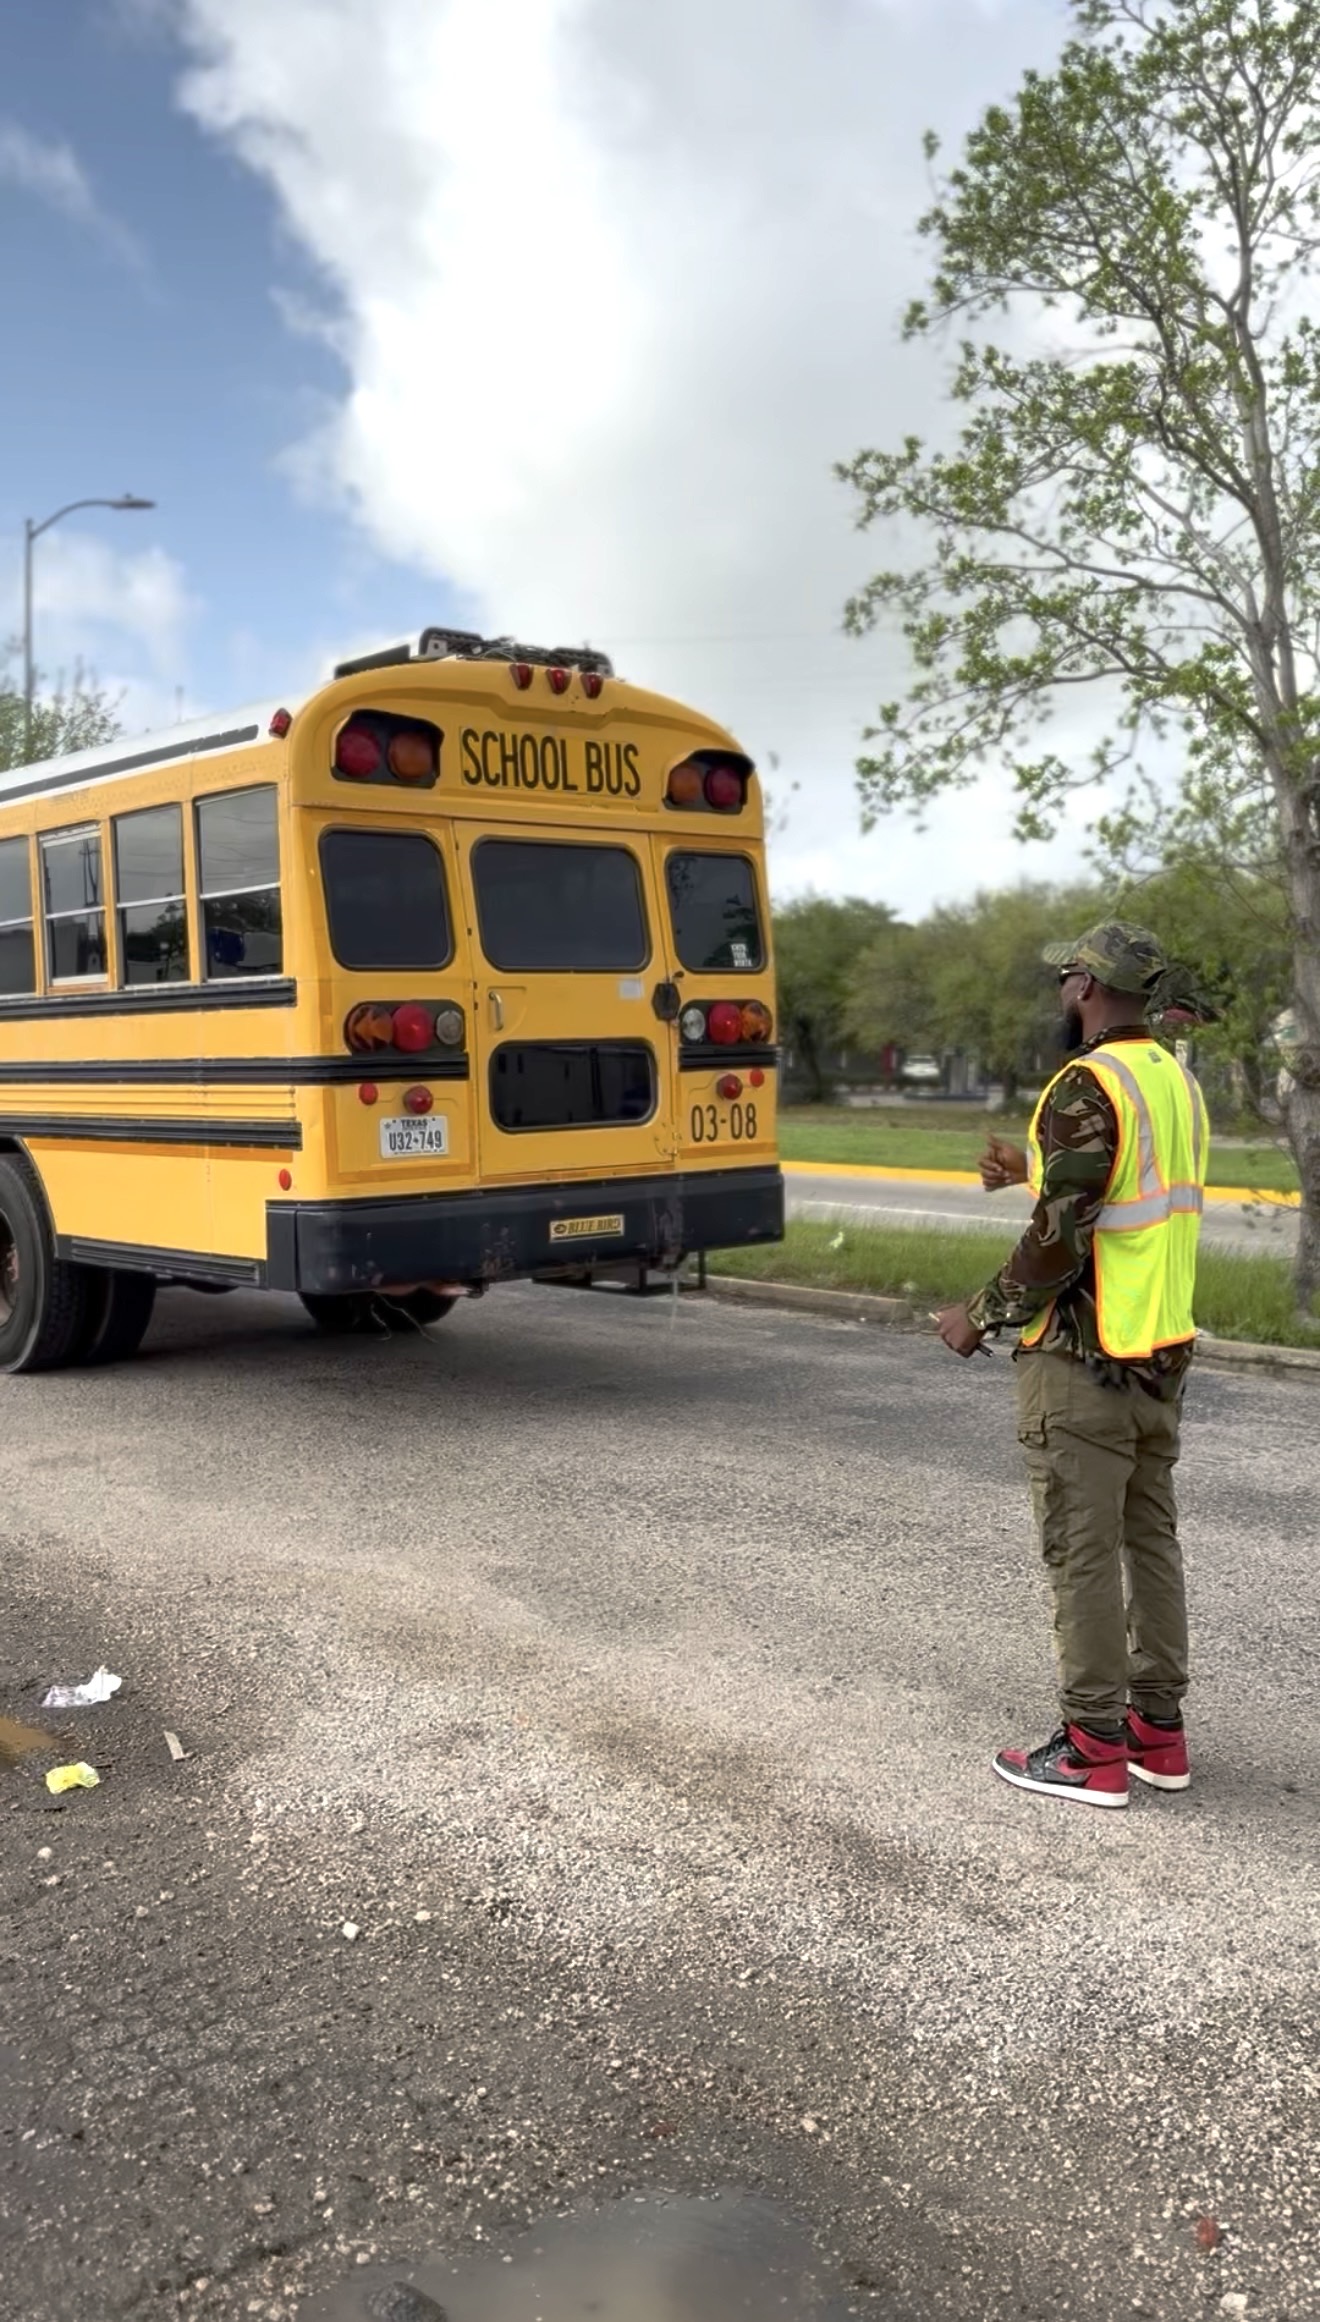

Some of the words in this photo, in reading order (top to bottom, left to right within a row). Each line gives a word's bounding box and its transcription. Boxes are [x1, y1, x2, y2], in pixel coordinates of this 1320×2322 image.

[462, 728, 578, 791] SCHOOL
[585, 741, 641, 796] BUS
[401, 1118, 428, 1127] TEXAS
[691, 1103, 757, 1142] 03-08
[568, 1221, 594, 1234] BLUE
